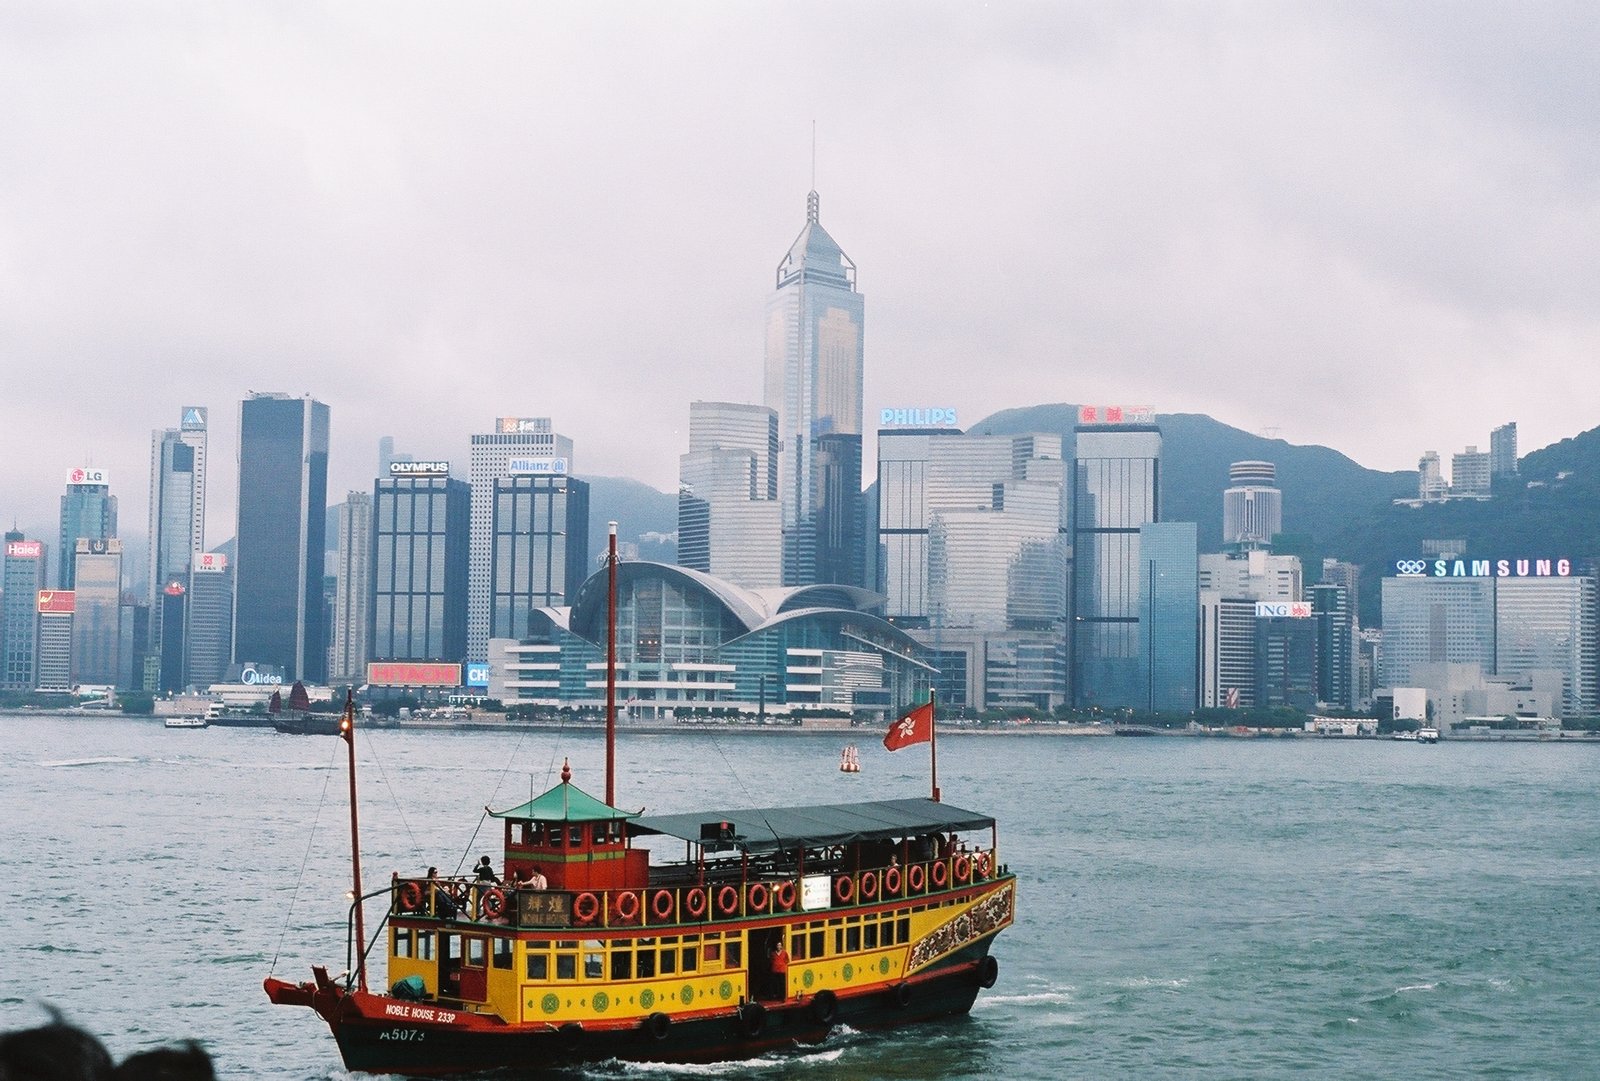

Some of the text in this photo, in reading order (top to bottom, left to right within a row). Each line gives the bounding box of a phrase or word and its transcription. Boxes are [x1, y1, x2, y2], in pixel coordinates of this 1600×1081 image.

[881, 407, 957, 425] PHILIPS
[390, 462, 449, 472] OLYMPUS
[510, 460, 549, 471] Allianz
[86, 472, 102, 481] LG
[8, 544, 39, 554] Haier
[1434, 559, 1570, 577] SAMSUNG
[1256, 605, 1288, 616] ING
[247, 672, 282, 684] Midea
[372, 665, 458, 683] HITACHI
[385, 1004, 456, 1024] NOBLE HOUSE 233P
